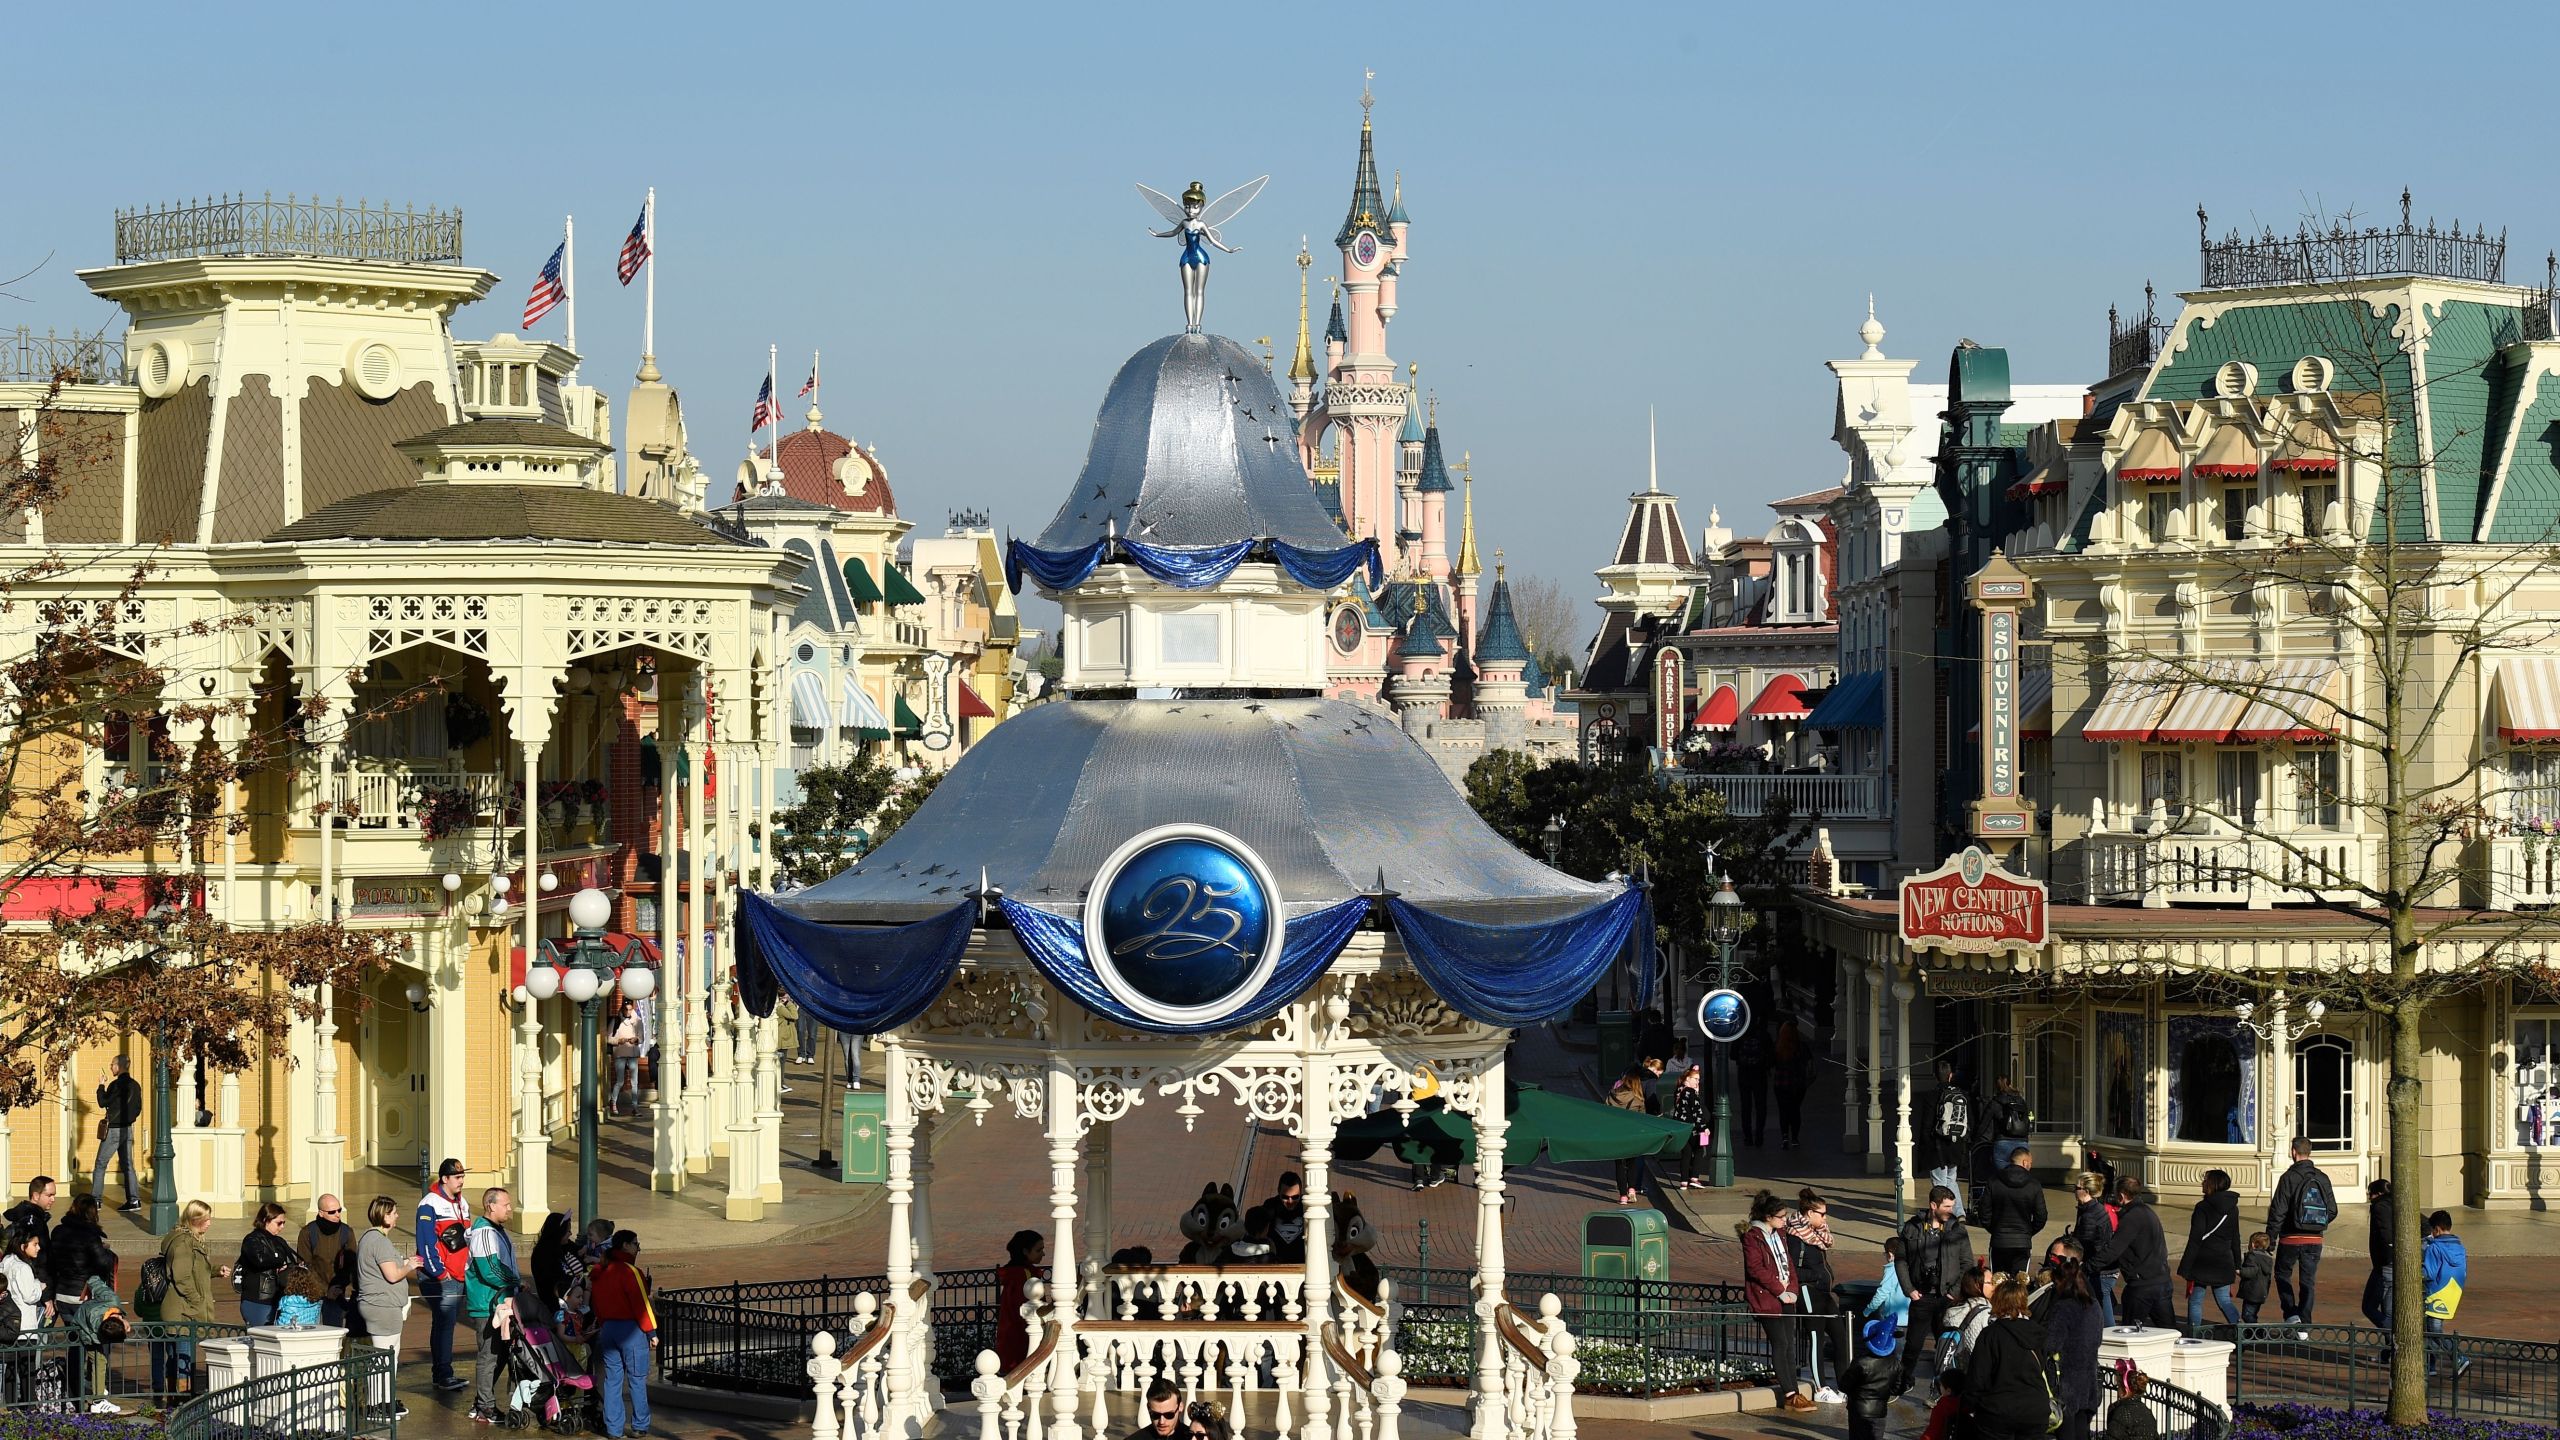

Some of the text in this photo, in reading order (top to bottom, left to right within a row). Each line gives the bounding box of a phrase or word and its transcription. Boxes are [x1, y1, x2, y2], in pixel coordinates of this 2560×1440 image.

[1665, 659, 1675, 747] MARKET HOUS
[1994, 631, 2009, 779] SOUVENIRS
[355, 887, 436, 905] PORIUM
[1114, 876, 1243, 960] 25
[1908, 886, 2037, 934] NEW CENTURY
[1920, 937, 1945, 946] Unique
[2000, 941, 2028, 950] Boutique
[1940, 912, 2004, 933] NOTIONS
